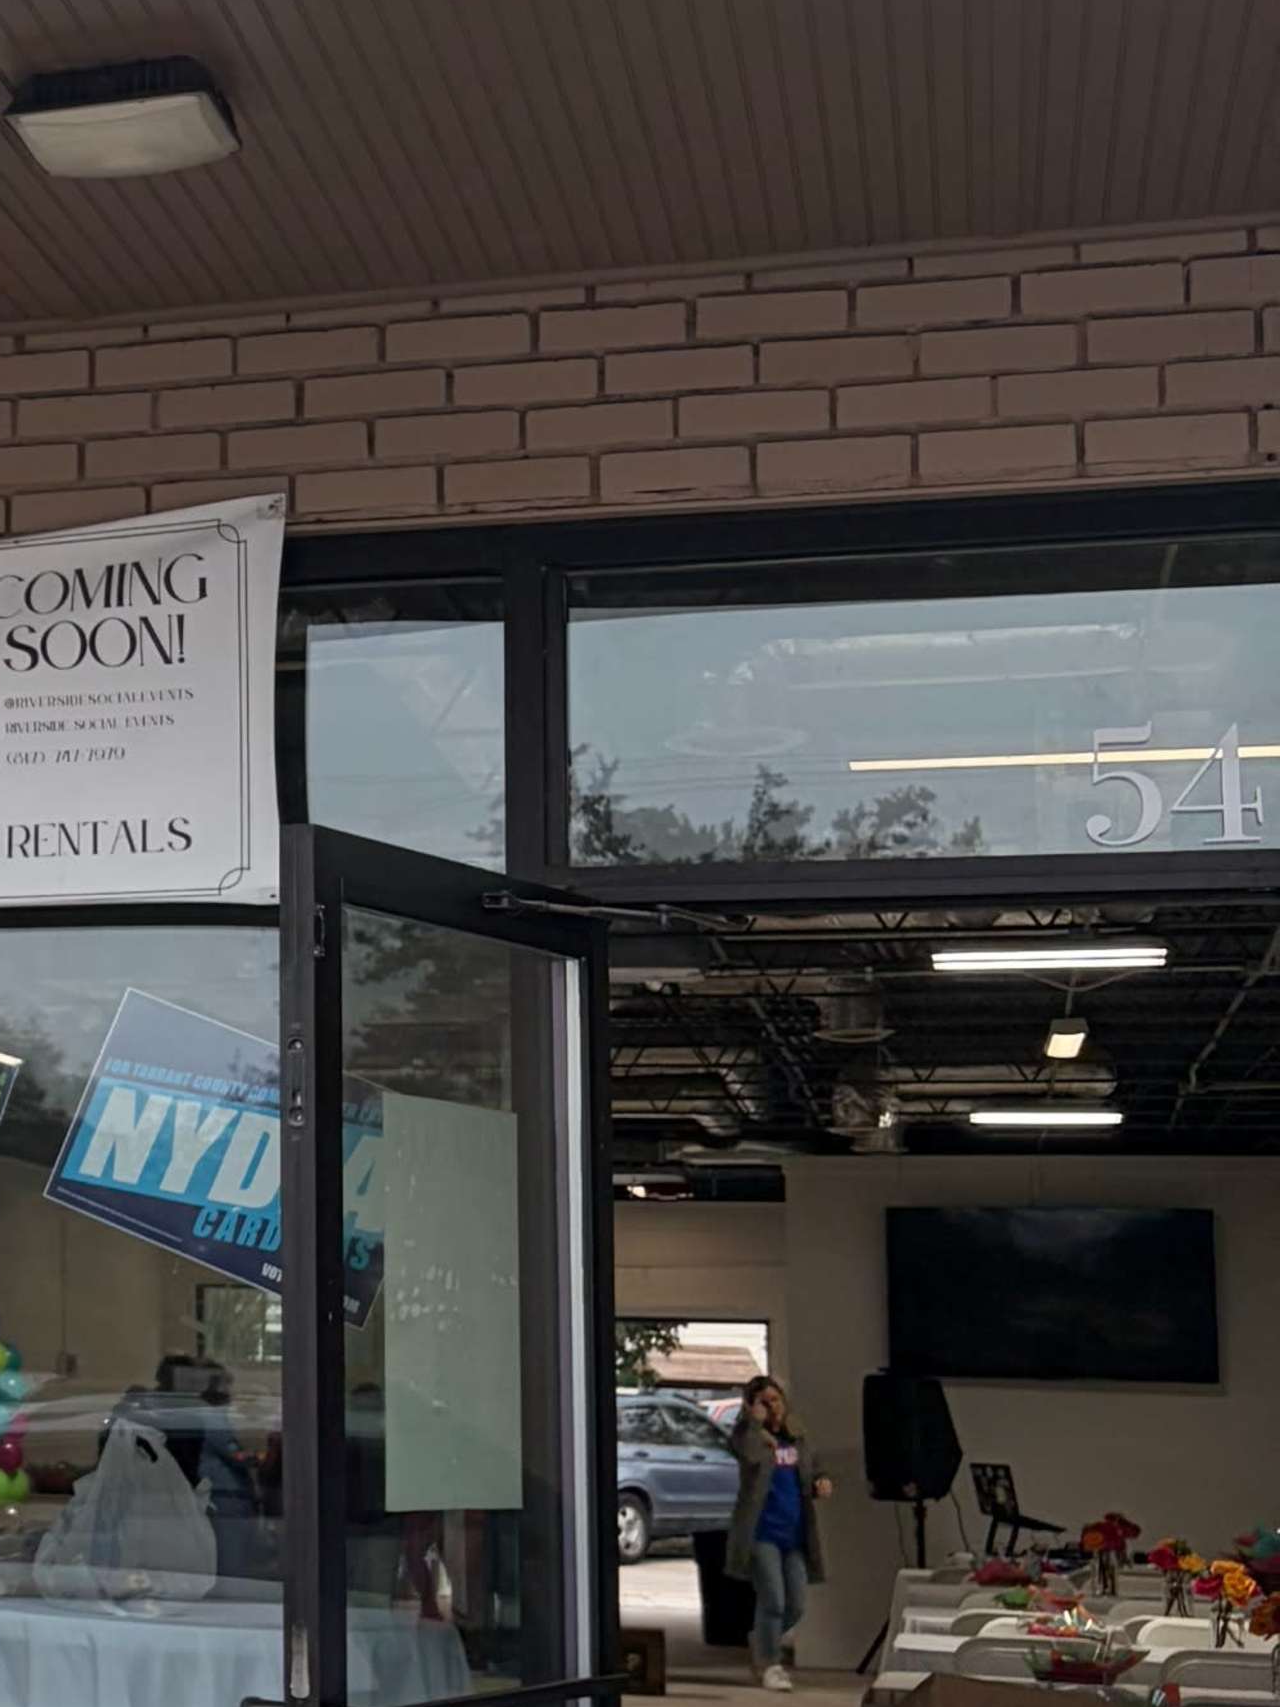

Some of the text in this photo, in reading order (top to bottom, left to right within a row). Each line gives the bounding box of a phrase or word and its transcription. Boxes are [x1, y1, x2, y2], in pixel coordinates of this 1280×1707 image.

[3, 614, 185, 672] SOON!
[1085, 720, 1263, 847] 54
[6, 817, 193, 860] RENTALS
[79, 1087, 384, 1233] NYDA
